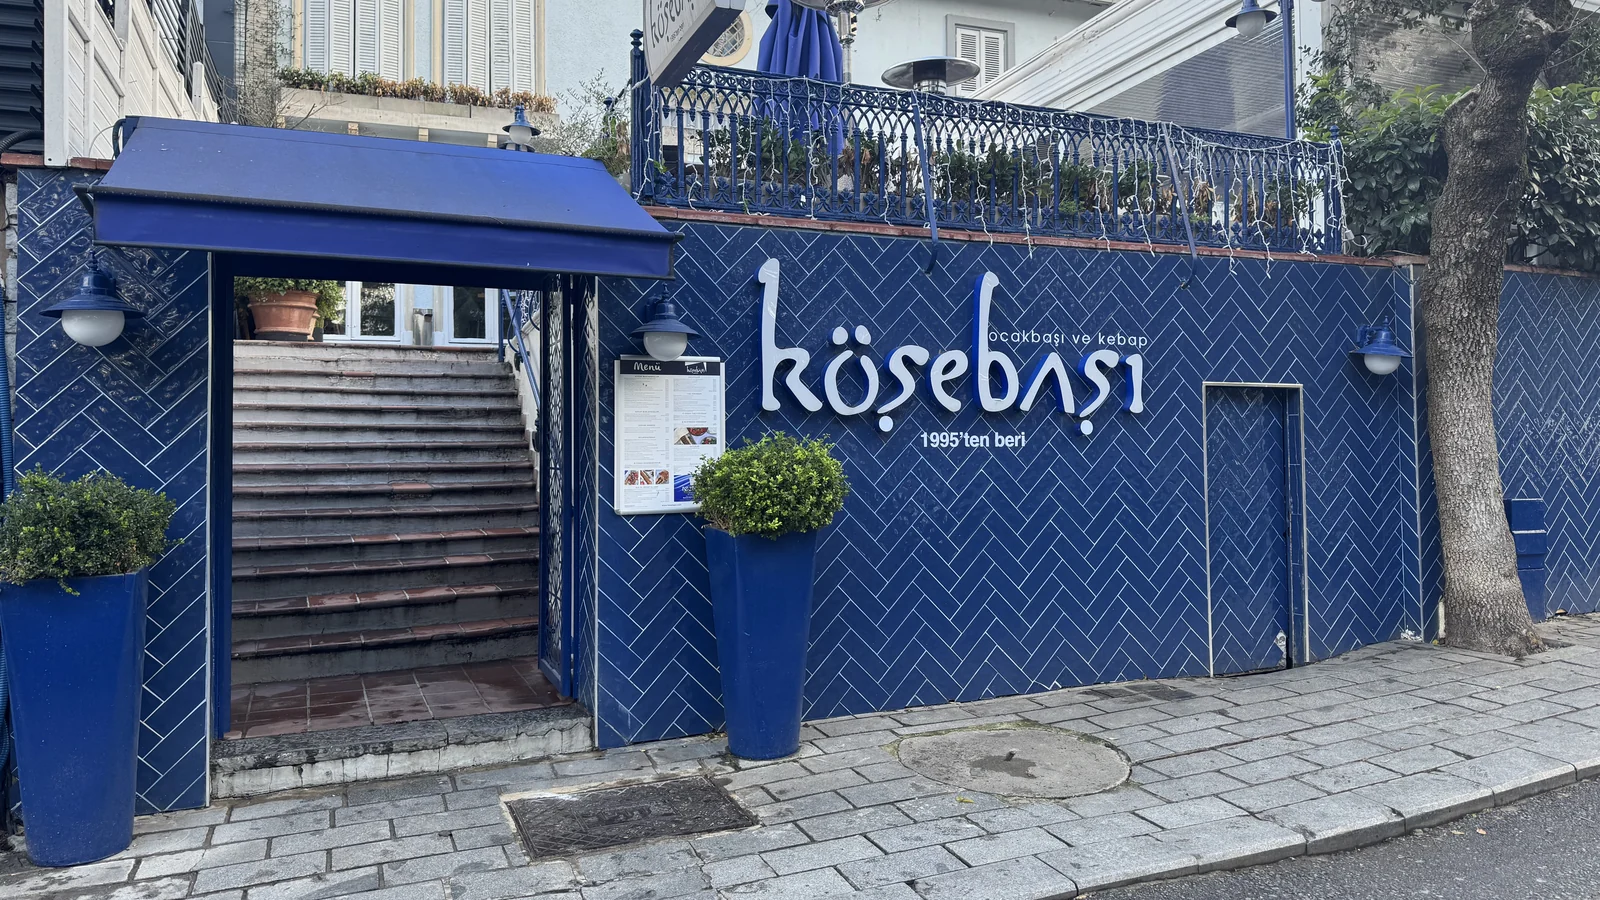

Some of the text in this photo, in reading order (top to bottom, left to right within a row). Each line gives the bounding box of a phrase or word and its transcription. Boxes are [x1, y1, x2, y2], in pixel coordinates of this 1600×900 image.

[988, 330, 1148, 348] ocakbaşı ve kebap
[633, 361, 662, 372] Menü
[920, 432, 1026, 447] 1995'ten beri
